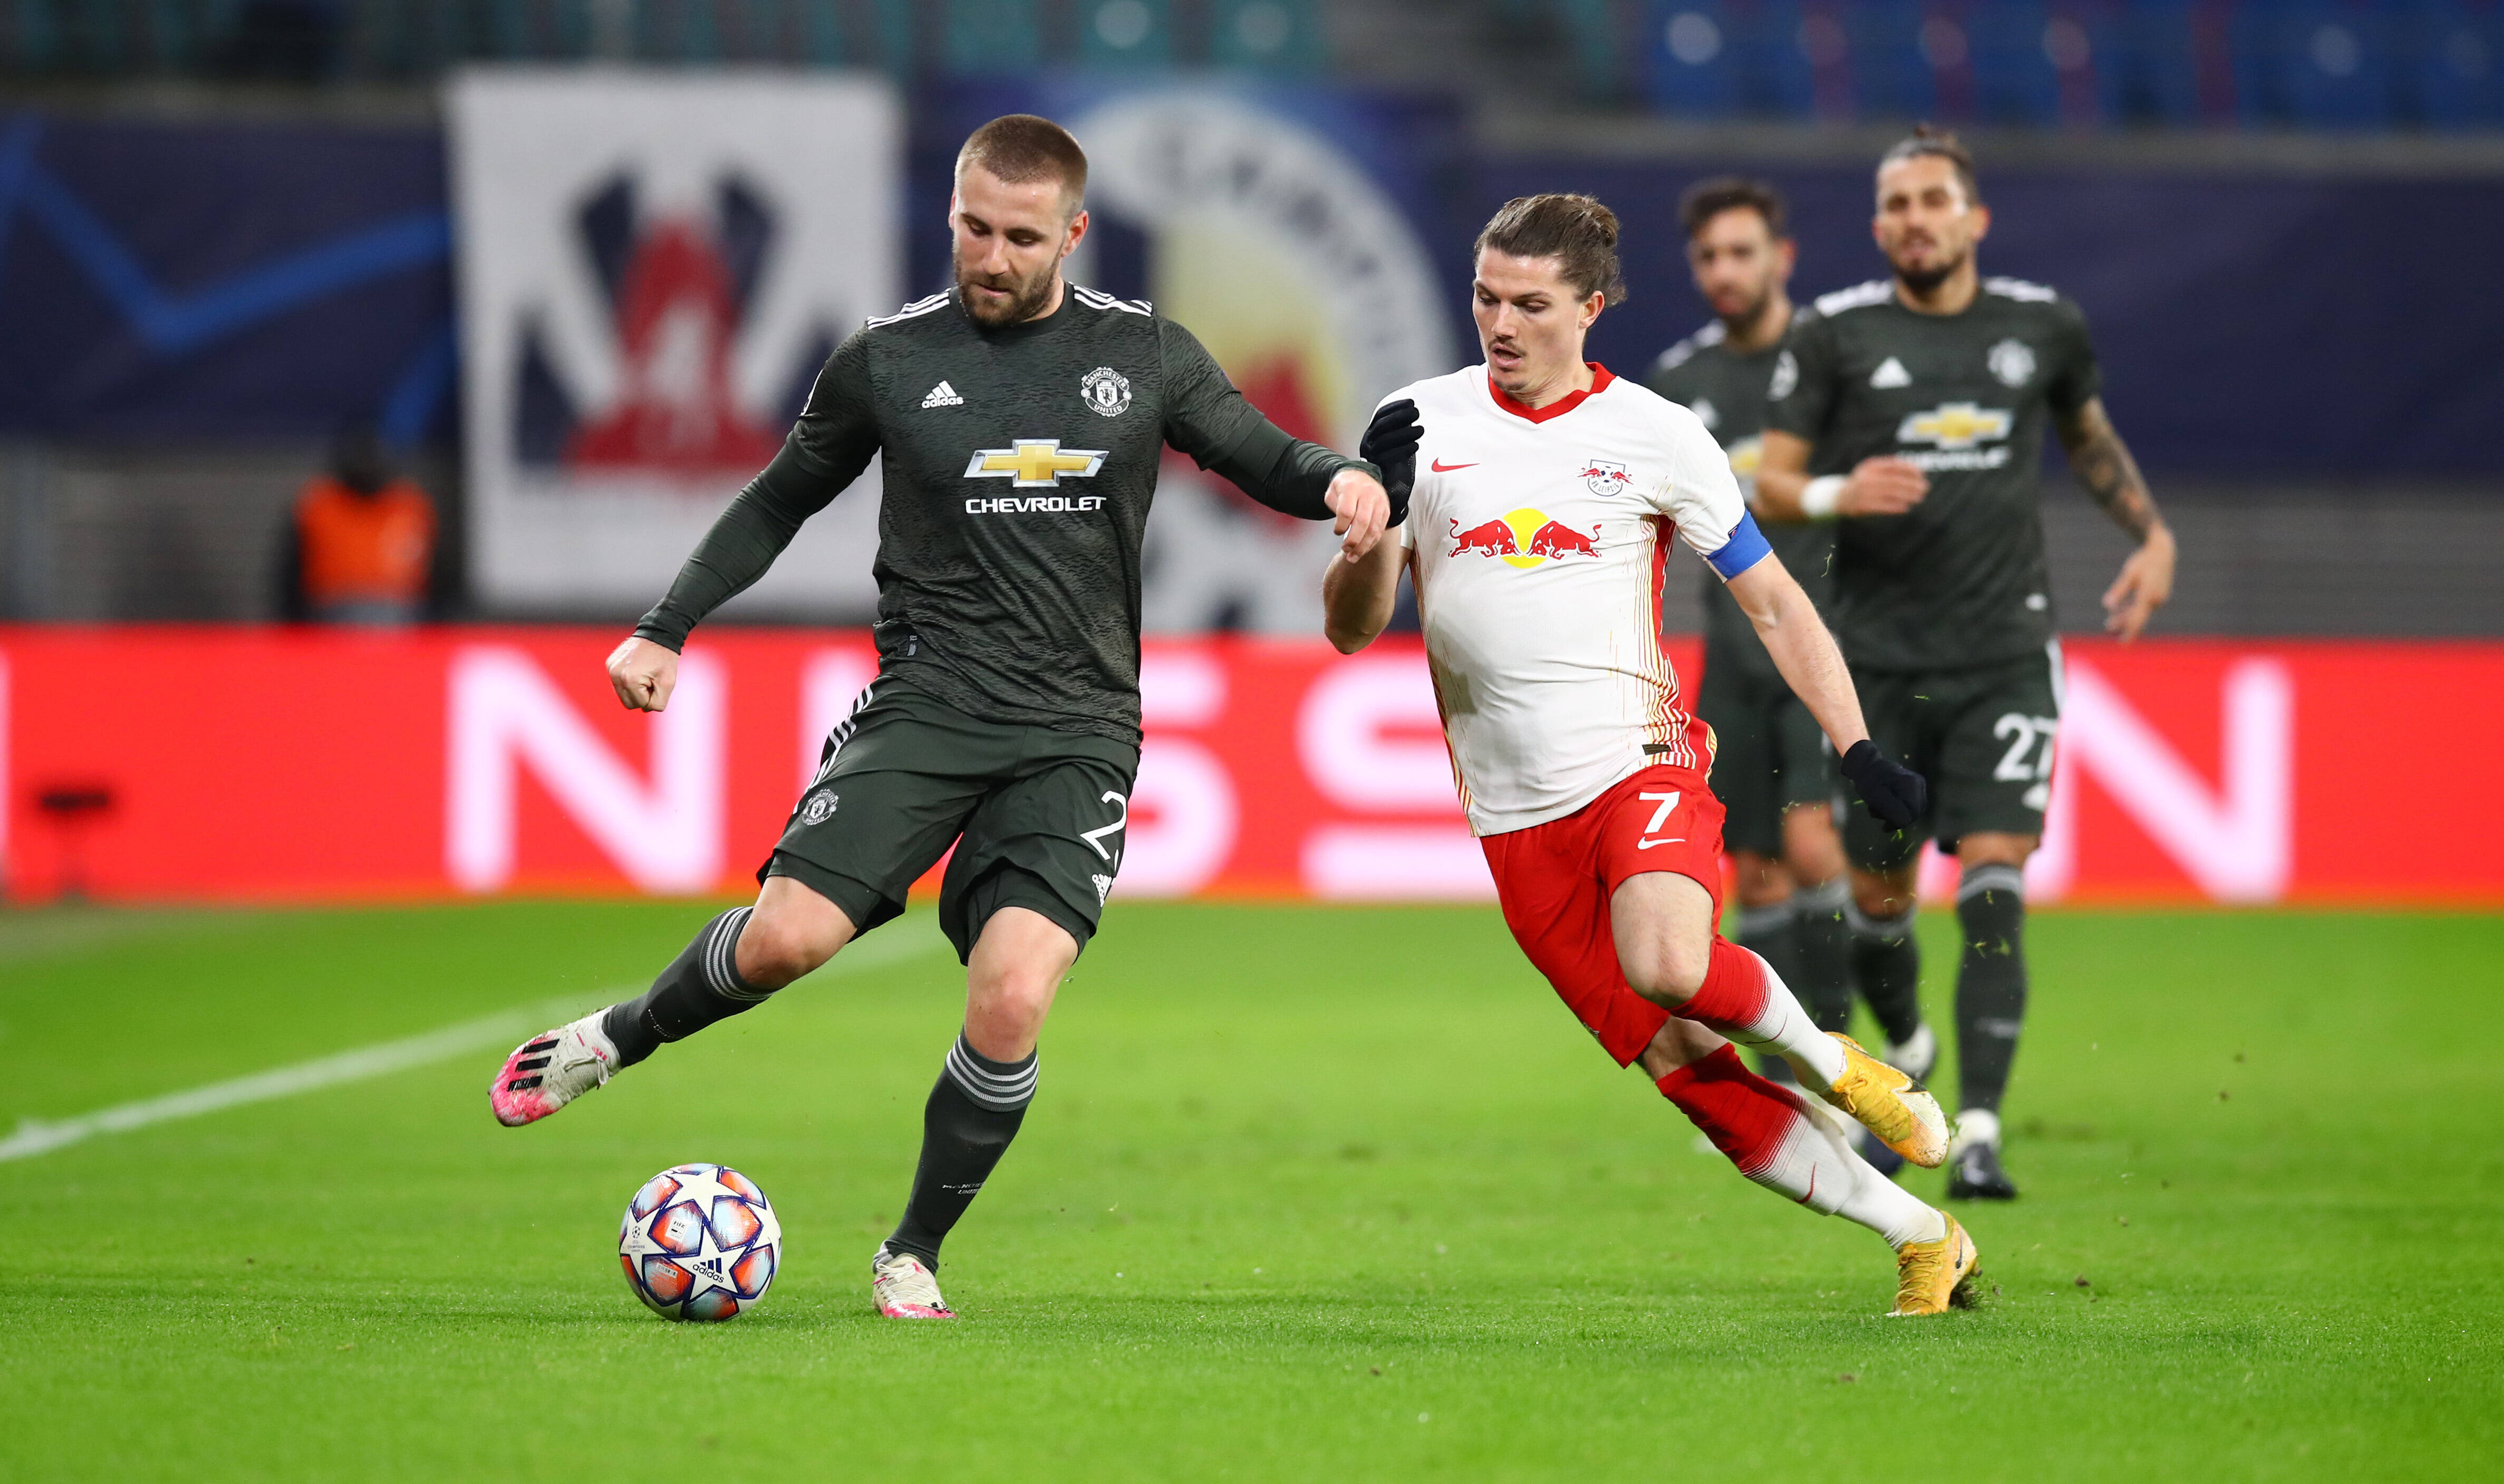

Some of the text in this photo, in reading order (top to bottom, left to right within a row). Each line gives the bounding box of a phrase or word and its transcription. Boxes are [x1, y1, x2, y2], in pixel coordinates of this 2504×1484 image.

[1085, 370, 1126, 388] MANCHESTER
[921, 397, 964, 409] adidas
[1094, 404, 1122, 414] UNITED
[1598, 483, 1620, 493] LEIPZIG
[965, 496, 1107, 514] CHEVROLET
[1993, 713, 2059, 781] 27
[443, 645, 2292, 896] NSN
[1639, 791, 1680, 834] 7
[692, 1264, 725, 1283] adidas
